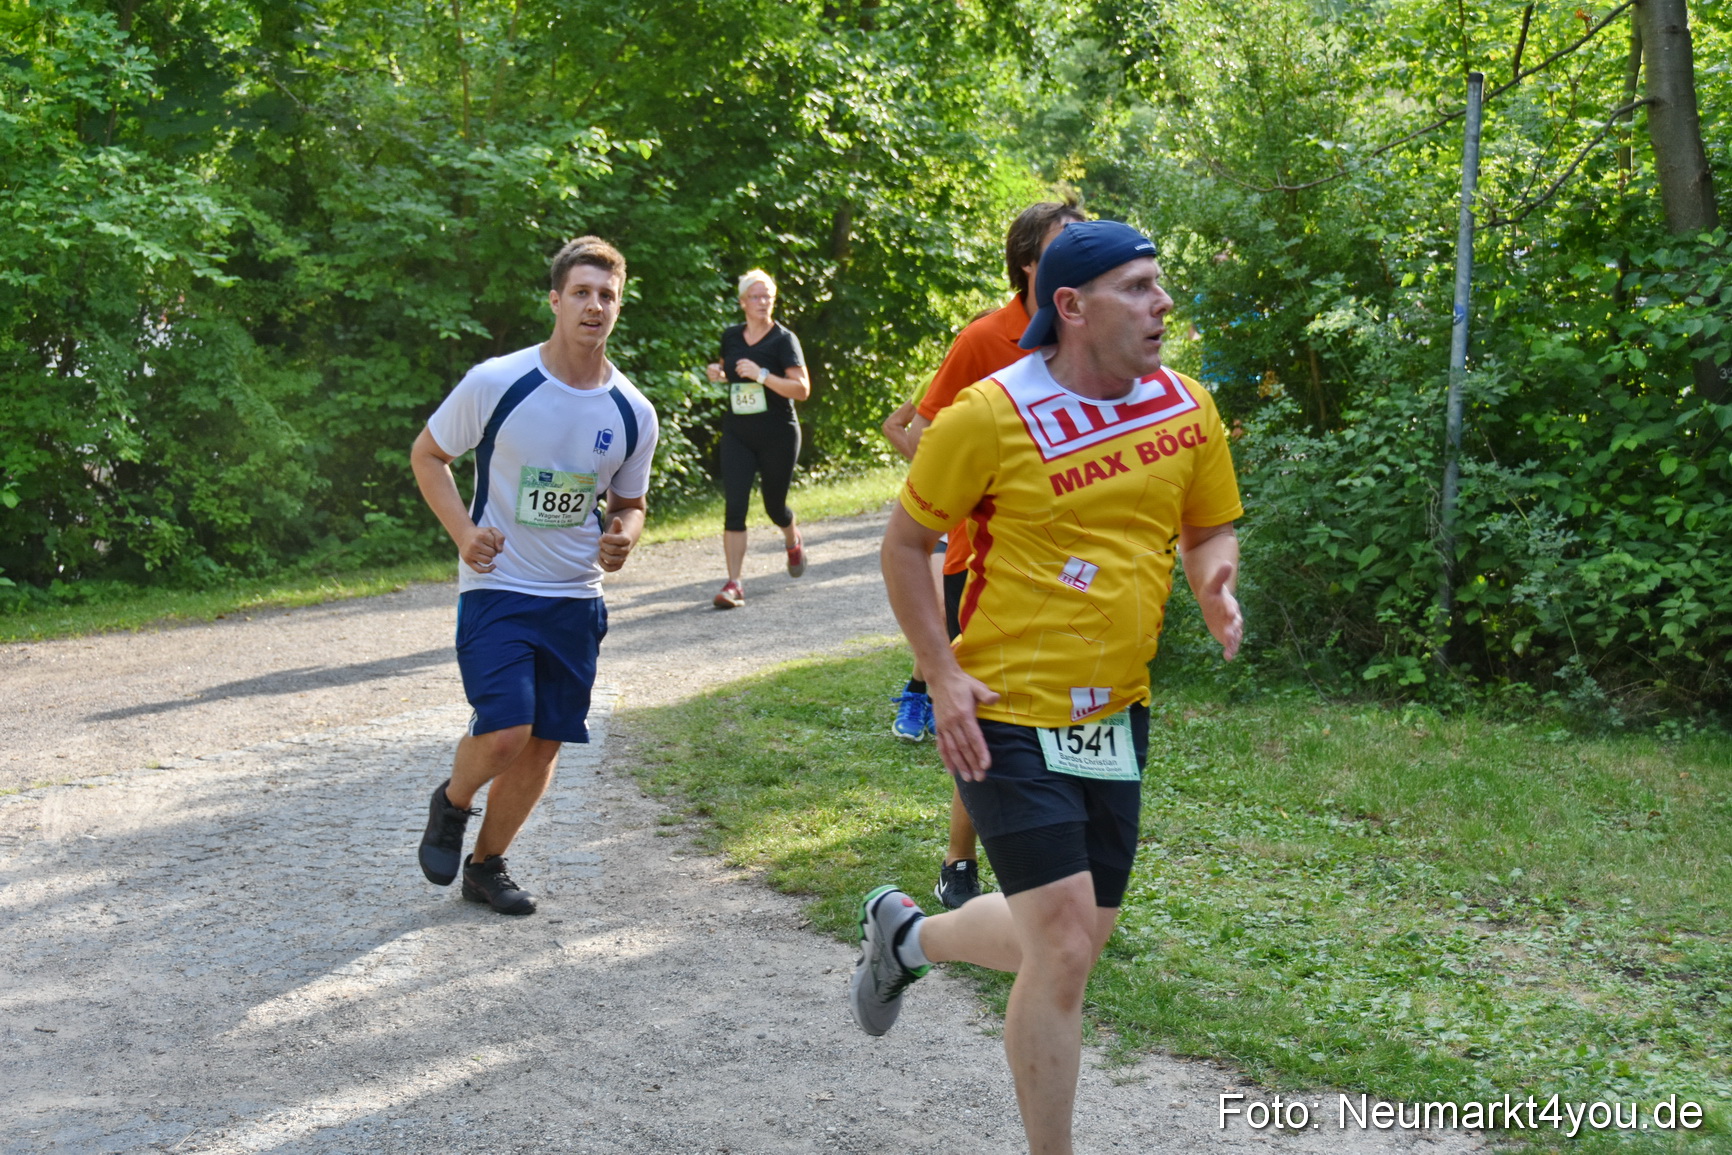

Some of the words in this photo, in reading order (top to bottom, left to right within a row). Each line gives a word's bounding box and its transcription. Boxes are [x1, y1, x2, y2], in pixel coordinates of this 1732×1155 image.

[736, 394, 756, 406] 845
[1049, 451, 1131, 497] MAX
[1134, 422, 1208, 466] BÖGL
[529, 489, 585, 513] 1882
[538, 512, 561, 520] Wagner
[1049, 725, 1117, 757] 1541
[1084, 757, 1118, 766] Christian
